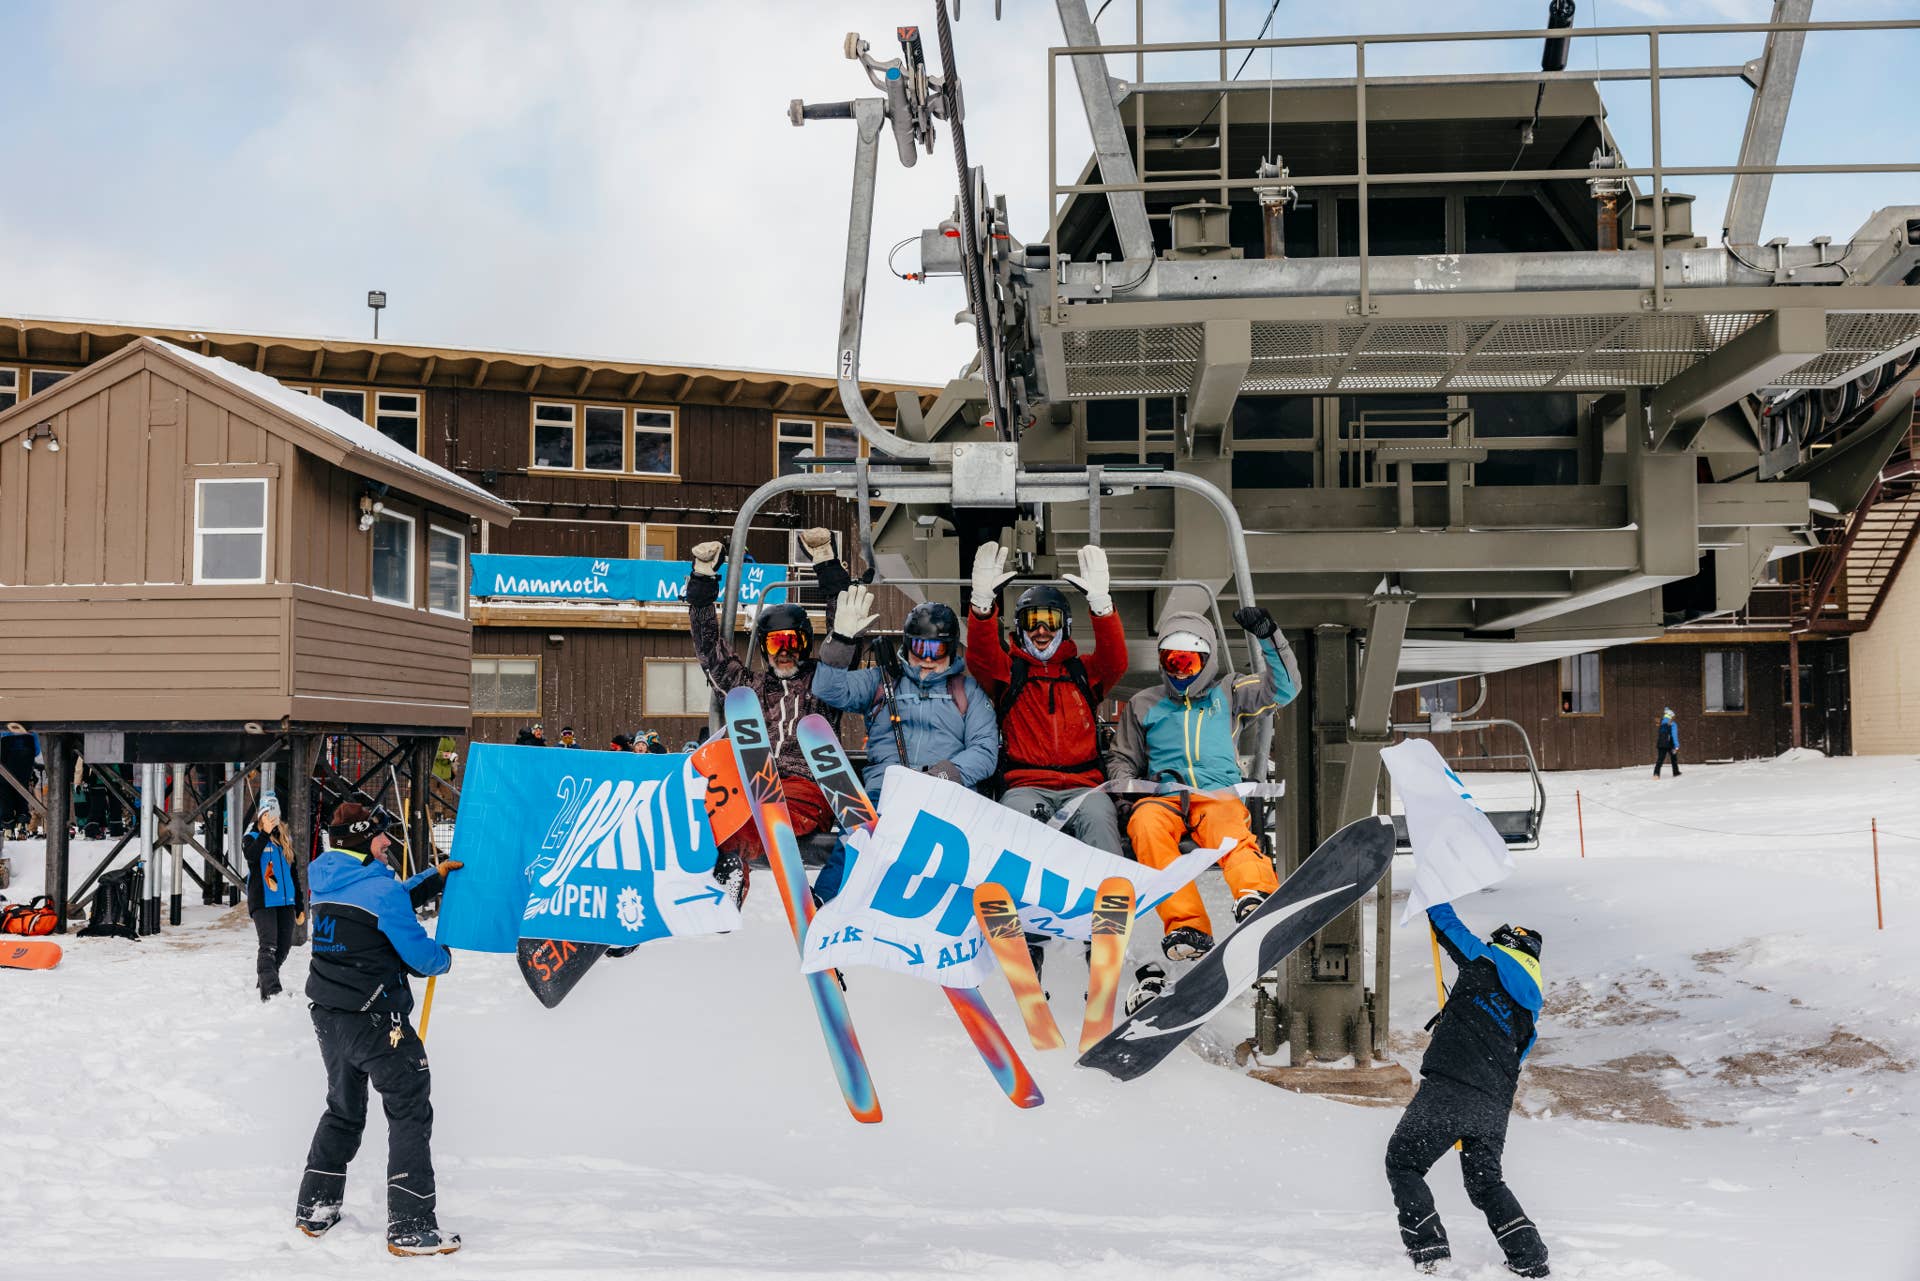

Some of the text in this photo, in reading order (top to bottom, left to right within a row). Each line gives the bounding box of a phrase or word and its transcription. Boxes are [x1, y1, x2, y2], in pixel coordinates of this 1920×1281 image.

[843, 350, 852, 376] 47
[494, 573, 608, 594] Mammoth
[657, 579, 761, 600] Math
[527, 939, 577, 981] YES.
